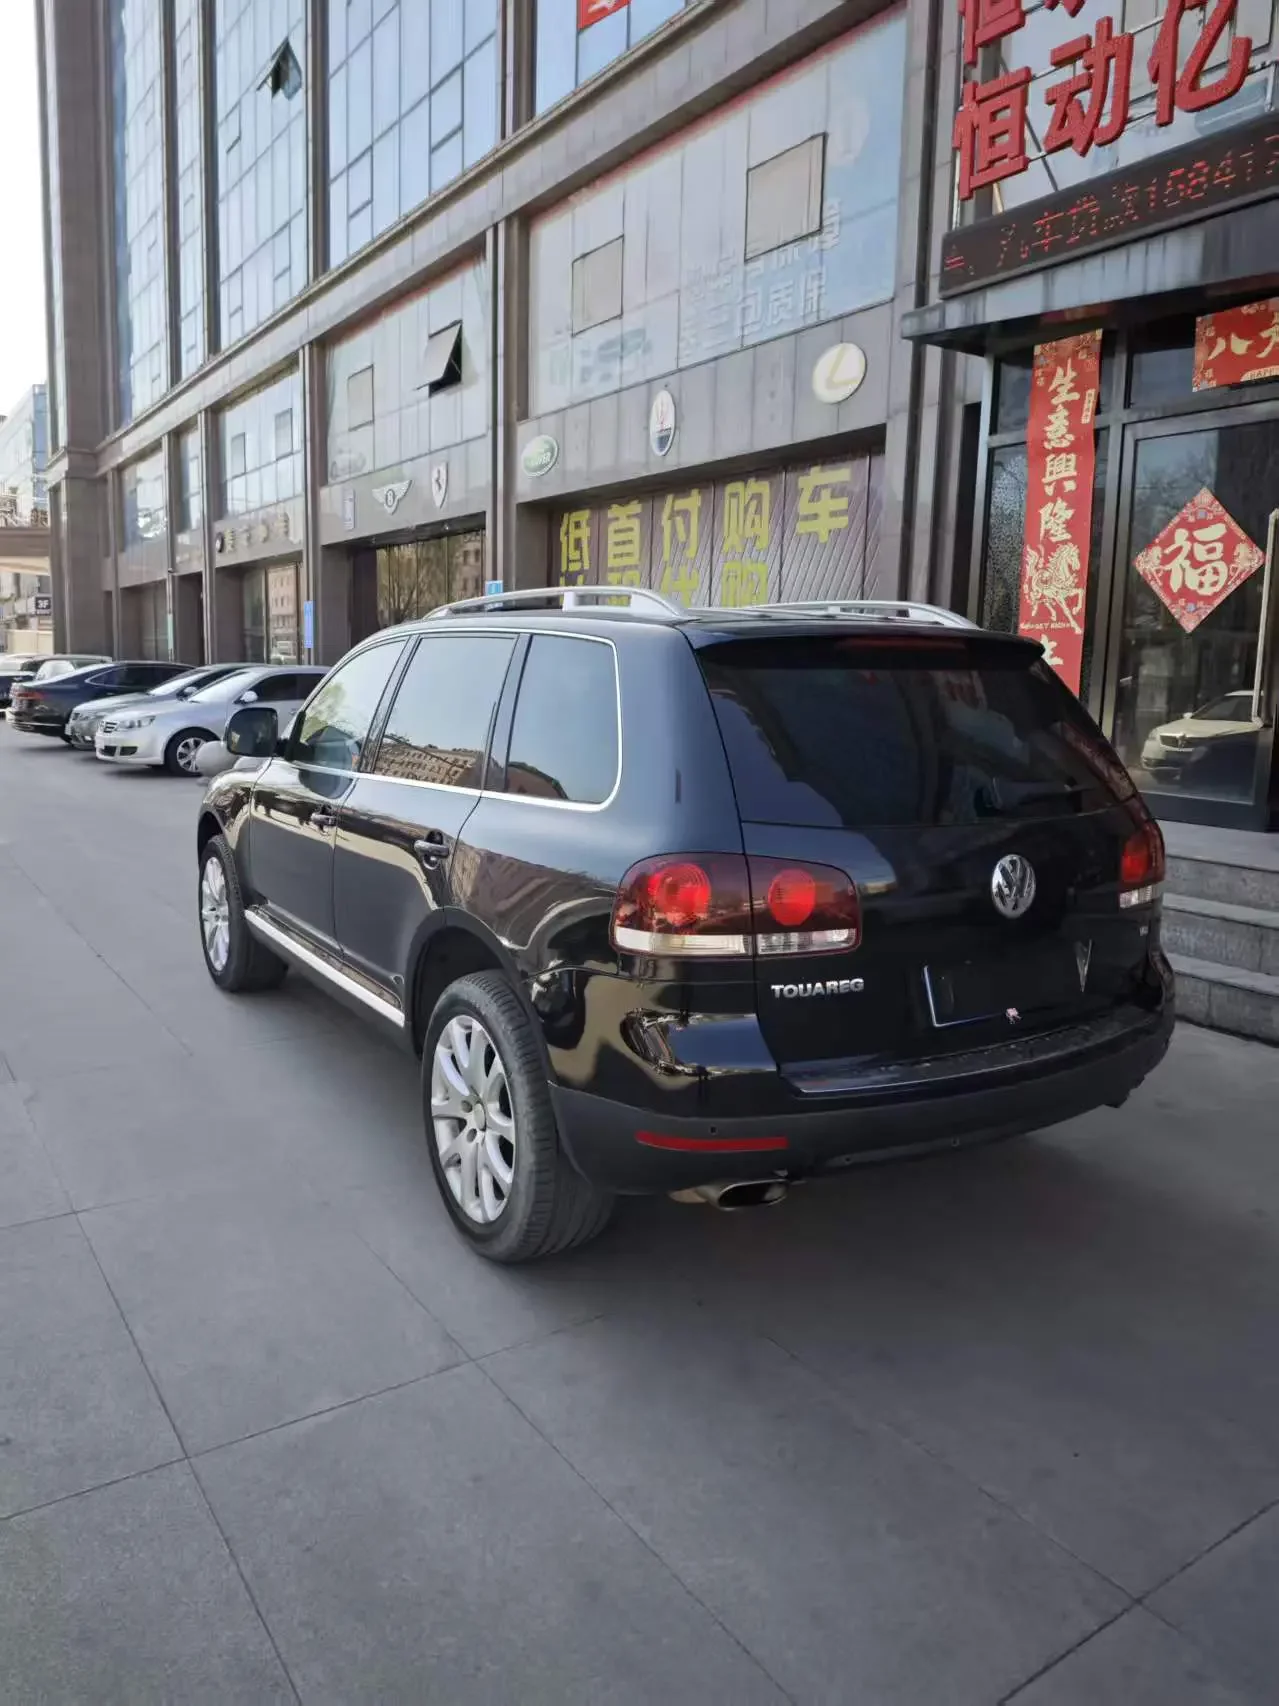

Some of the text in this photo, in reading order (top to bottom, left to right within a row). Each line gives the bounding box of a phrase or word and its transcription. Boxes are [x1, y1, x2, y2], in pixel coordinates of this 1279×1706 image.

[559, 466, 851, 572] 低首付购车
[1161, 523, 1229, 596] 福
[770, 977, 865, 999] TOUAREG
